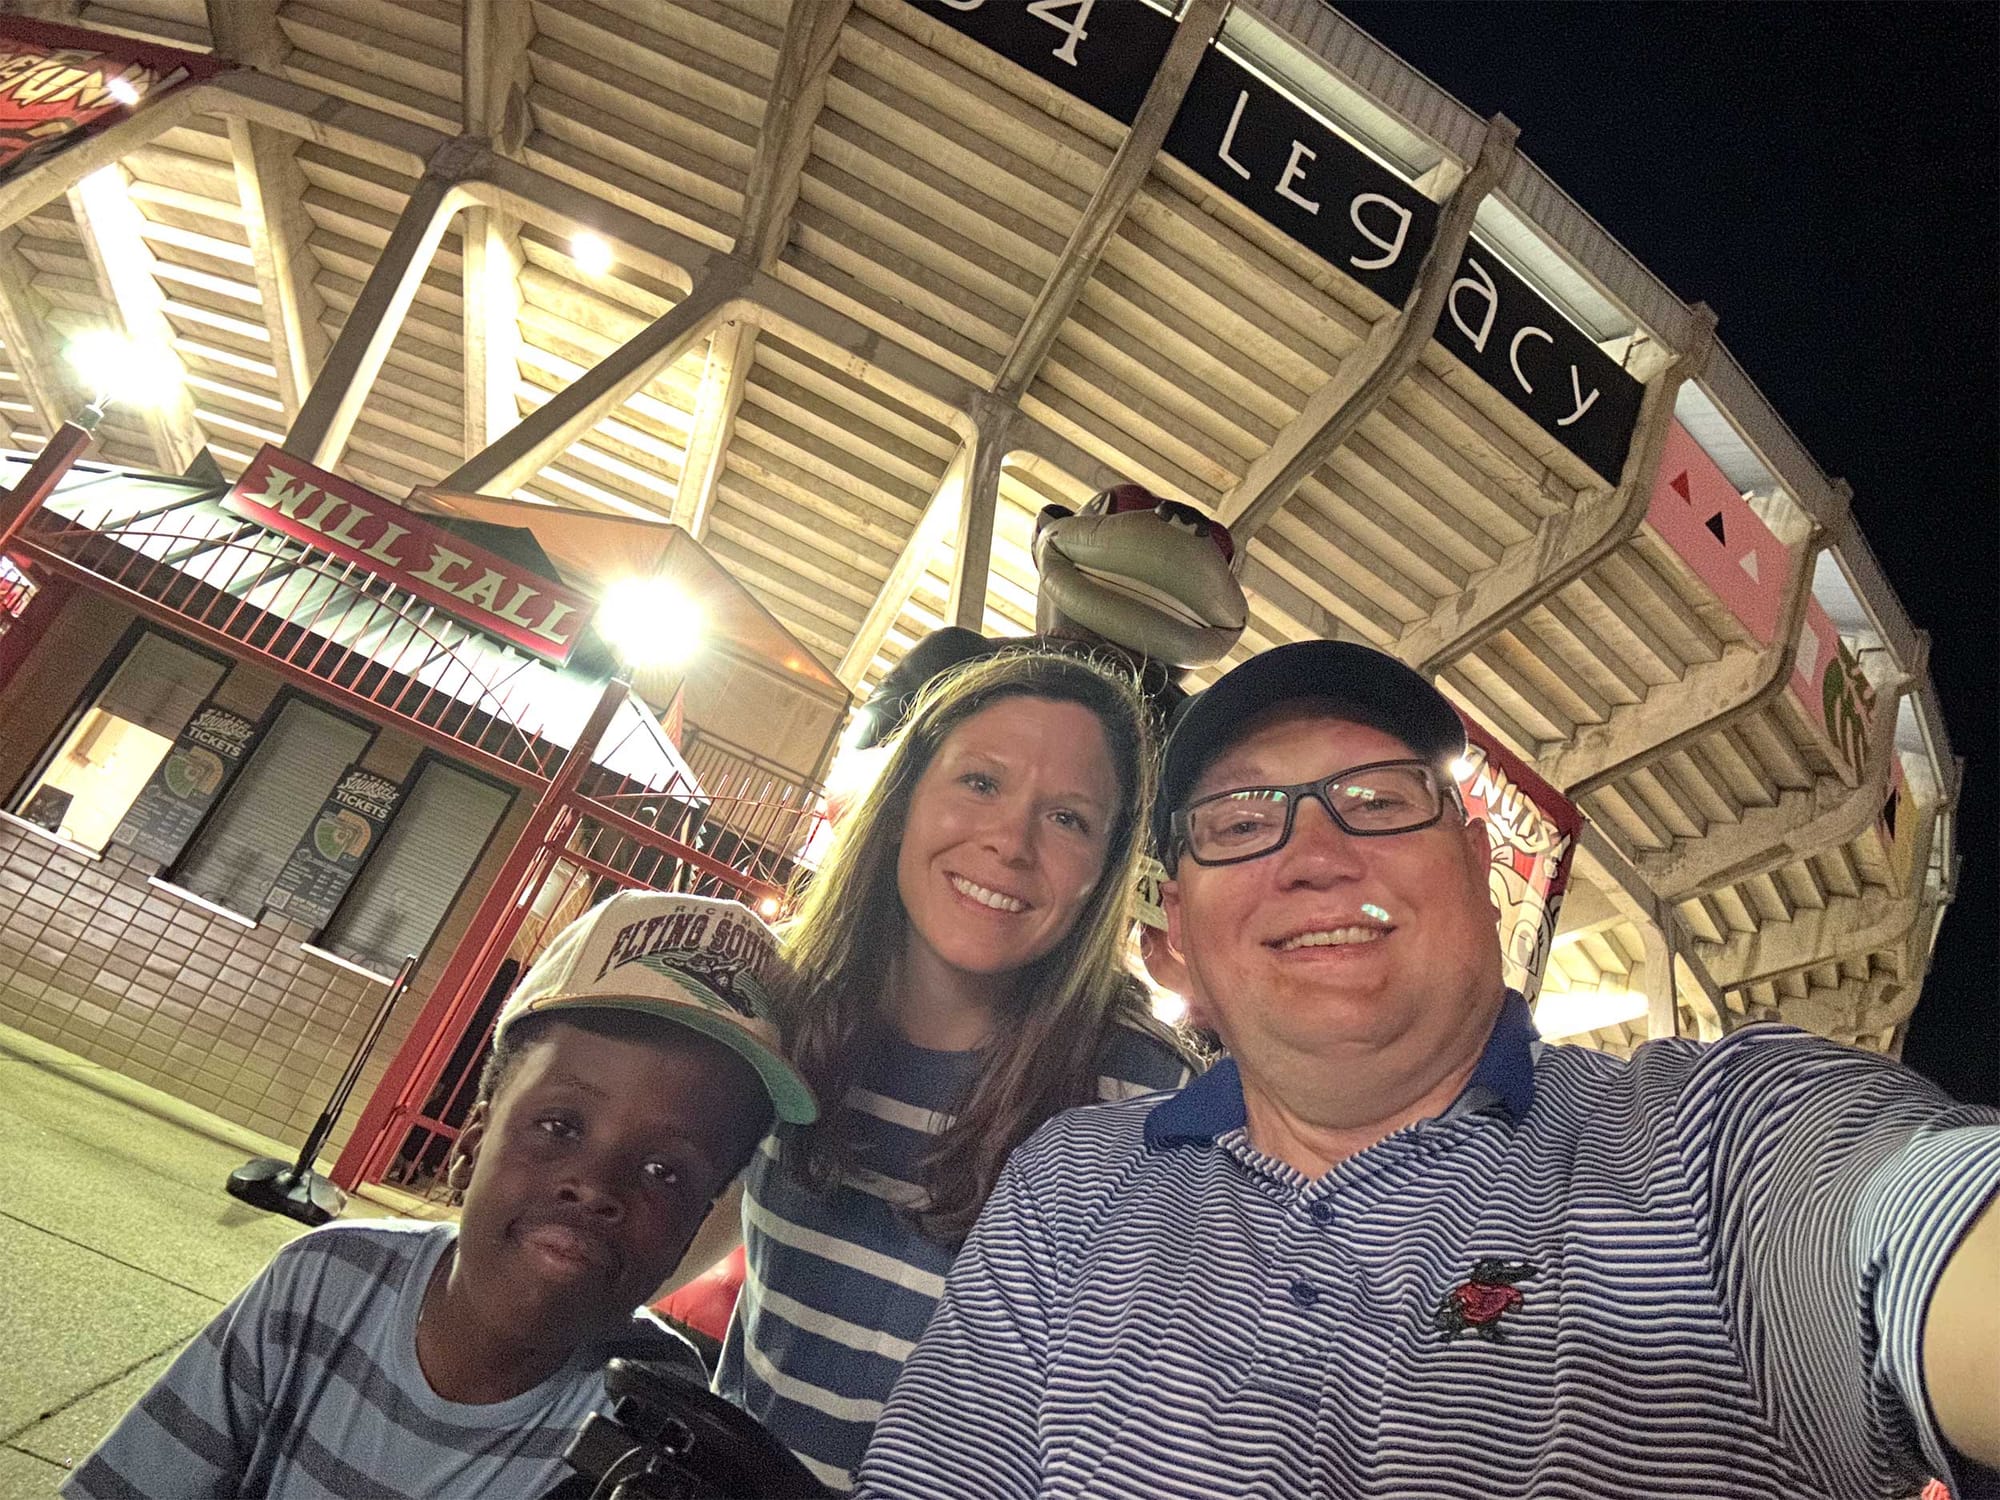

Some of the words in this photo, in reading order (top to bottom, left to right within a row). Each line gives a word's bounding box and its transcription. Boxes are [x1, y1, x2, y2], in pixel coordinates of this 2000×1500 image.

[243, 464, 412, 567] WILL
[406, 543, 577, 645] CALL
[188, 726, 242, 758] TICKETS
[335, 790, 389, 820] TICKETS
[674, 904, 775, 945] RICHMO
[593, 914, 710, 984] FLYING
